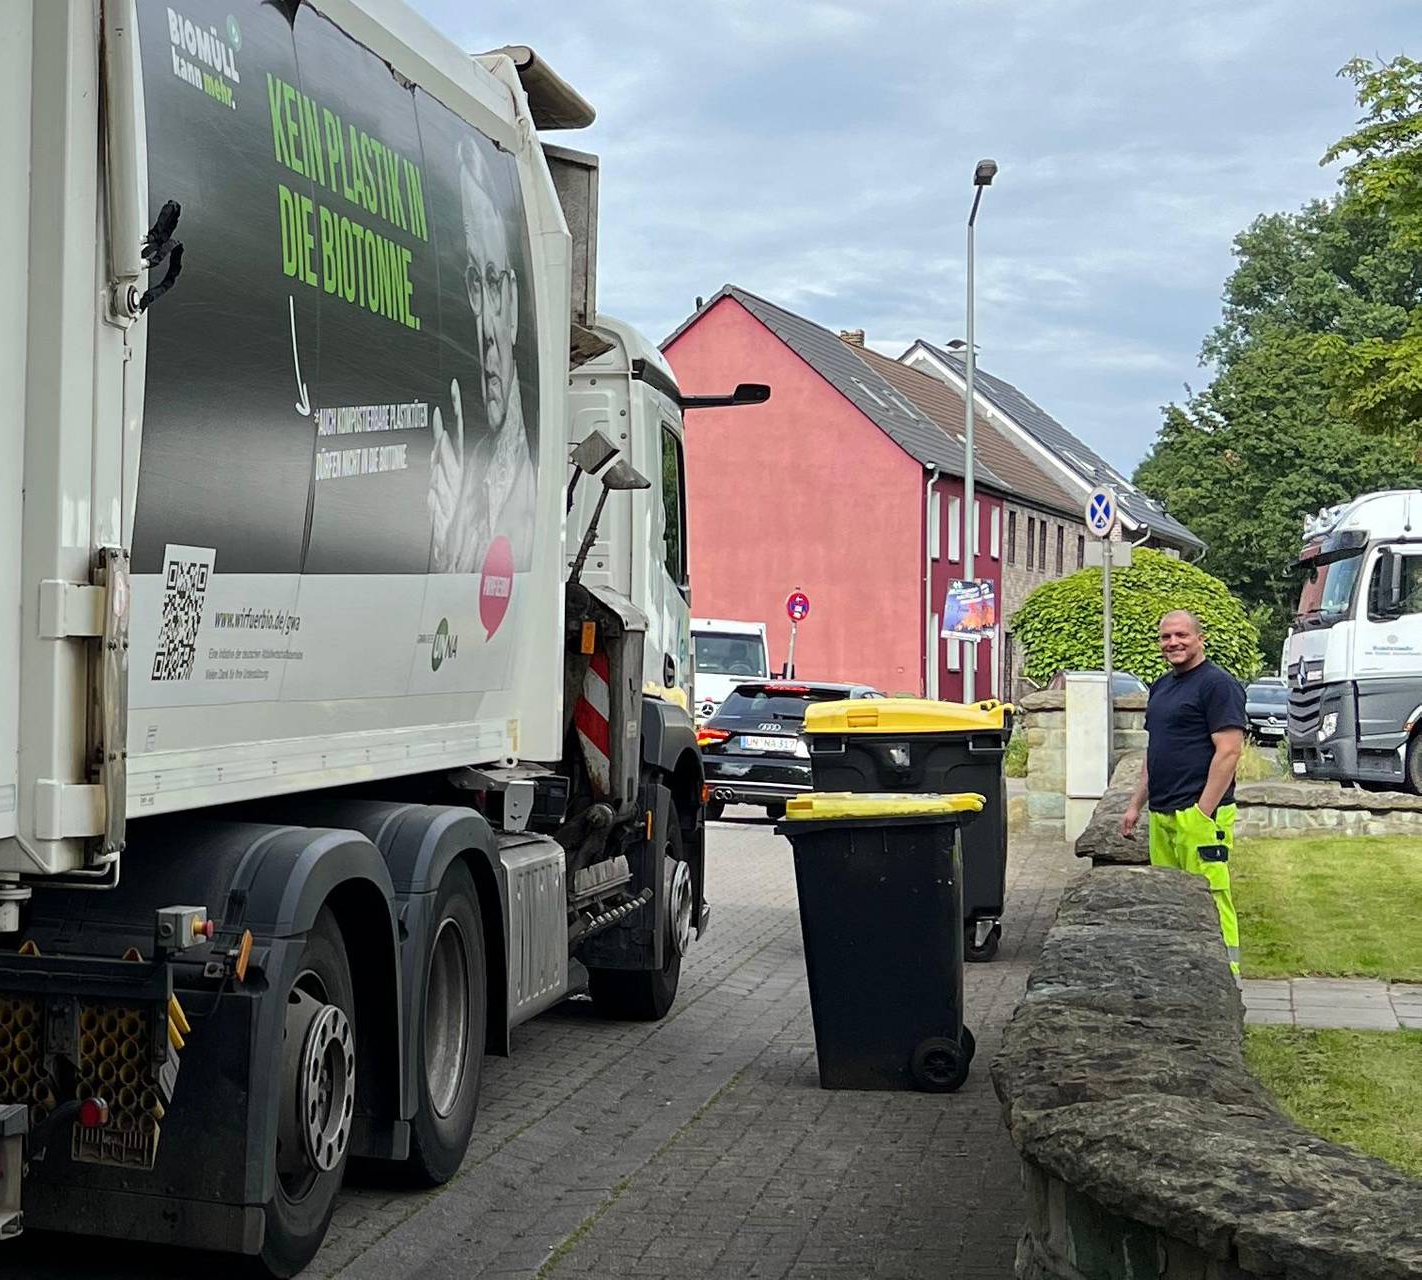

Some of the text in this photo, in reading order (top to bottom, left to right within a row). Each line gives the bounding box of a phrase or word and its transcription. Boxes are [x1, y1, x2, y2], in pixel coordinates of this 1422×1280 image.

[167, 7, 241, 83] BIOMÜLL
[171, 45, 236, 110] kann mehr.
[266, 72, 428, 242] KEIN PLASTIK IN
[278, 183, 421, 331] DIE BIOTONNE.
[214, 607, 301, 635] www.wirfuerbio.de/gwa
